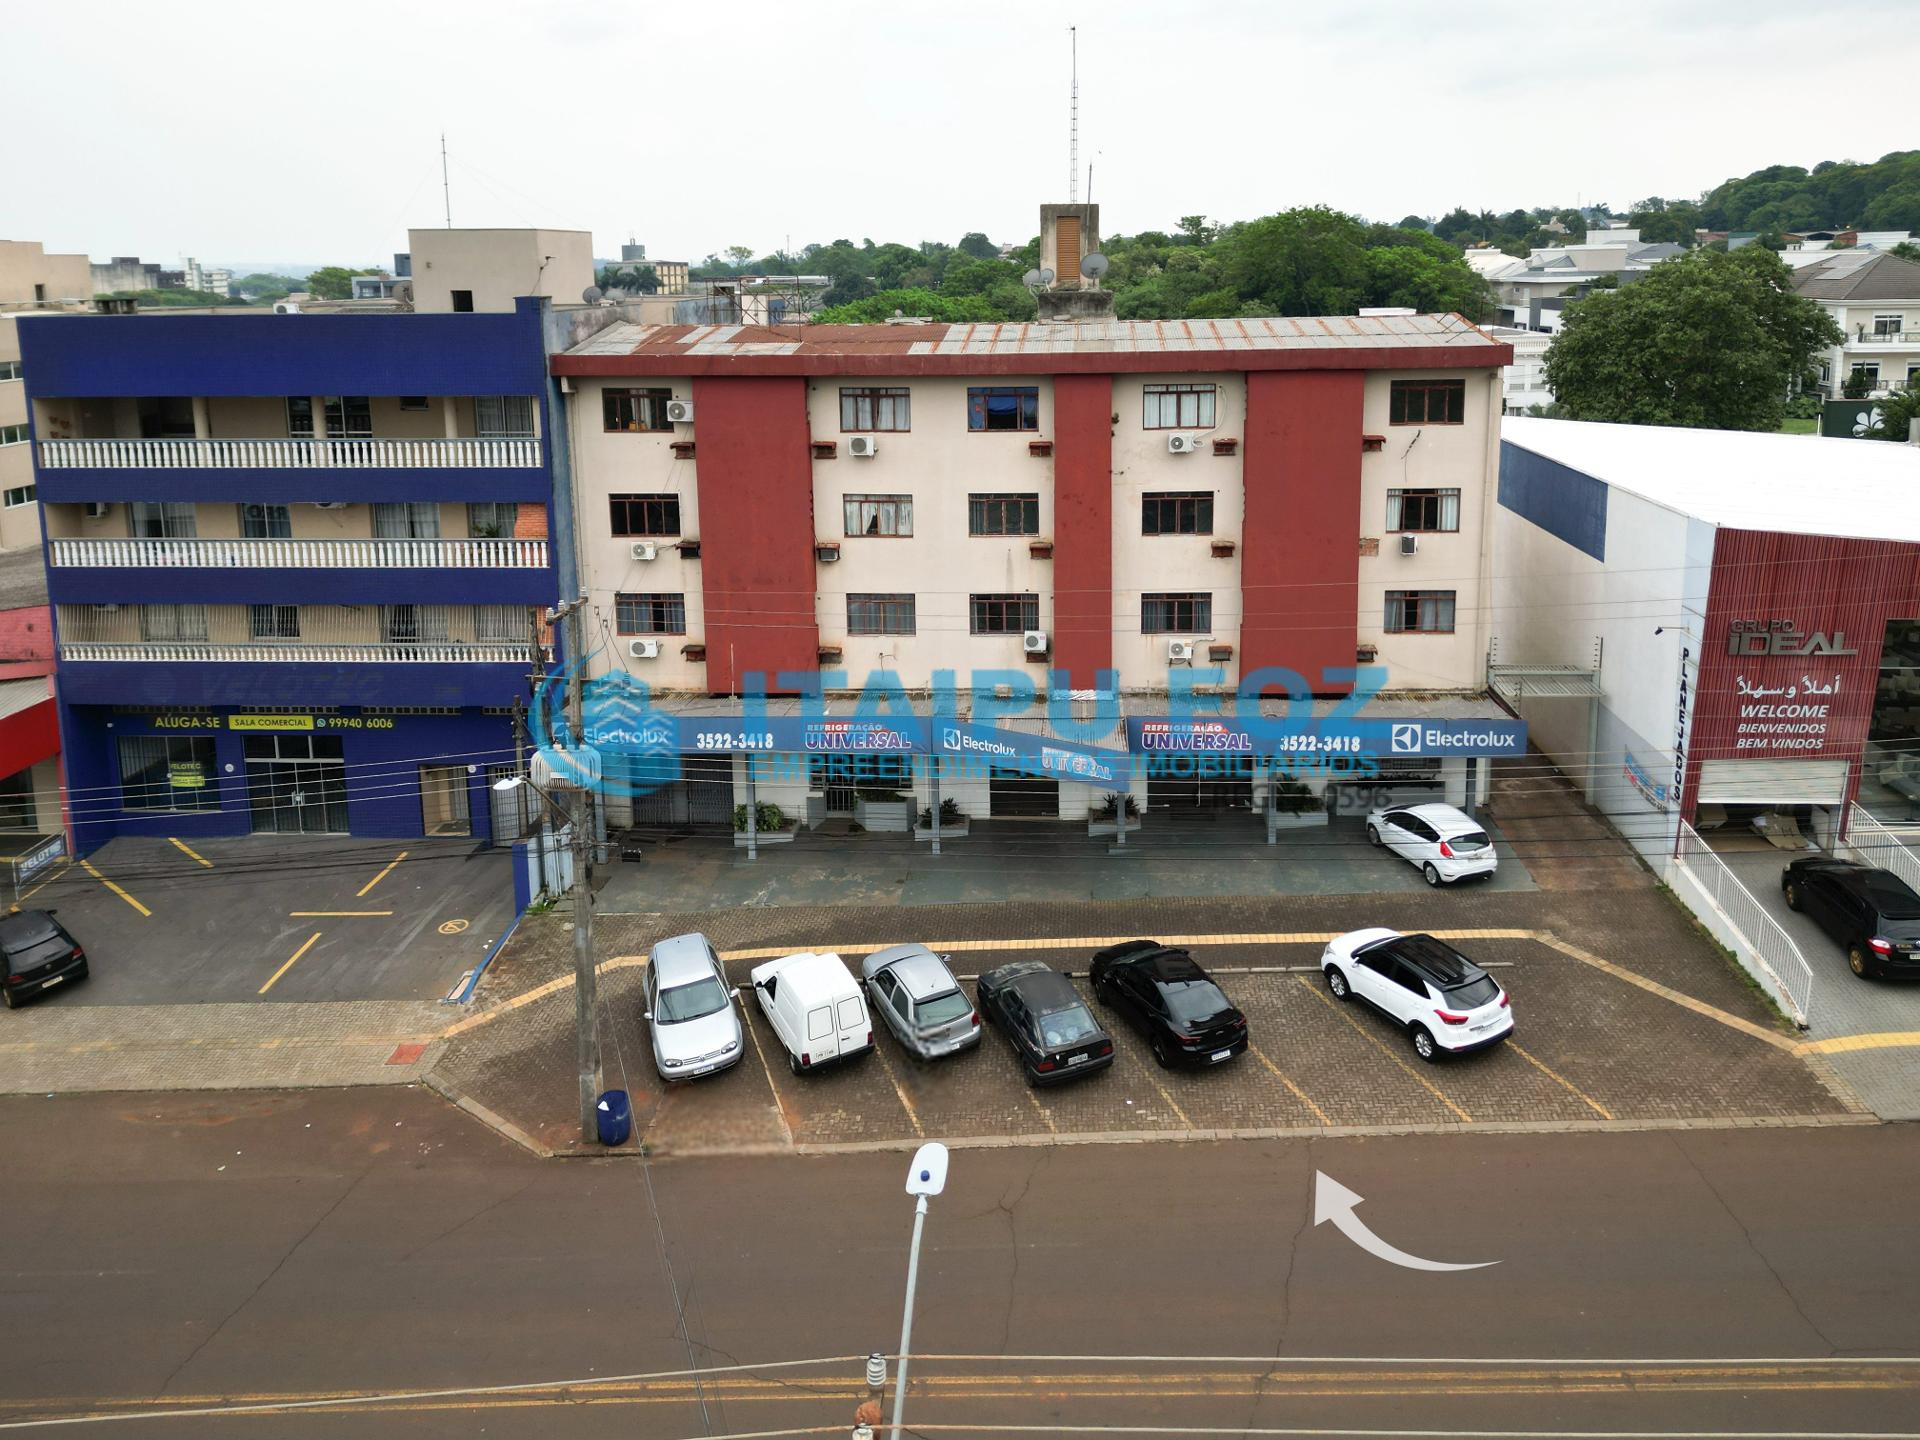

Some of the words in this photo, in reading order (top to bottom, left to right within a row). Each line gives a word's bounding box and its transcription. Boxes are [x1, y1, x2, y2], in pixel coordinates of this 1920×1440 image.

[1731, 619, 1795, 633] GRUPO
[1740, 705, 1829, 718] WELCOME
[155, 716, 220, 728] ALUGA-SE
[234, 719, 253, 727] SALA
[257, 718, 307, 728] COMERCIAL
[328, 717, 362, 729] 99940
[366, 718, 393, 729] 6006
[807, 722, 883, 732] REFRIGERAÇÃO
[1144, 723, 1223, 733] REFRIGERAÇÃO
[1674, 648, 1689, 801] PLANEJADOS
[1737, 723, 1826, 733] BIENVENIDOS
[583, 728, 669, 745] Electrolux
[696, 733, 774, 749] 3522-3418
[805, 731, 912, 750] UNIVERSAL
[1141, 733, 1252, 751] UNIVERSAL
[1280, 735, 1361, 752] 3522-3418
[1426, 729, 1516, 748] Electrolux
[1737, 738, 1767, 748] BEM
[1772, 738, 1824, 748] VINDOS
[962, 735, 1016, 757] Electrolux
